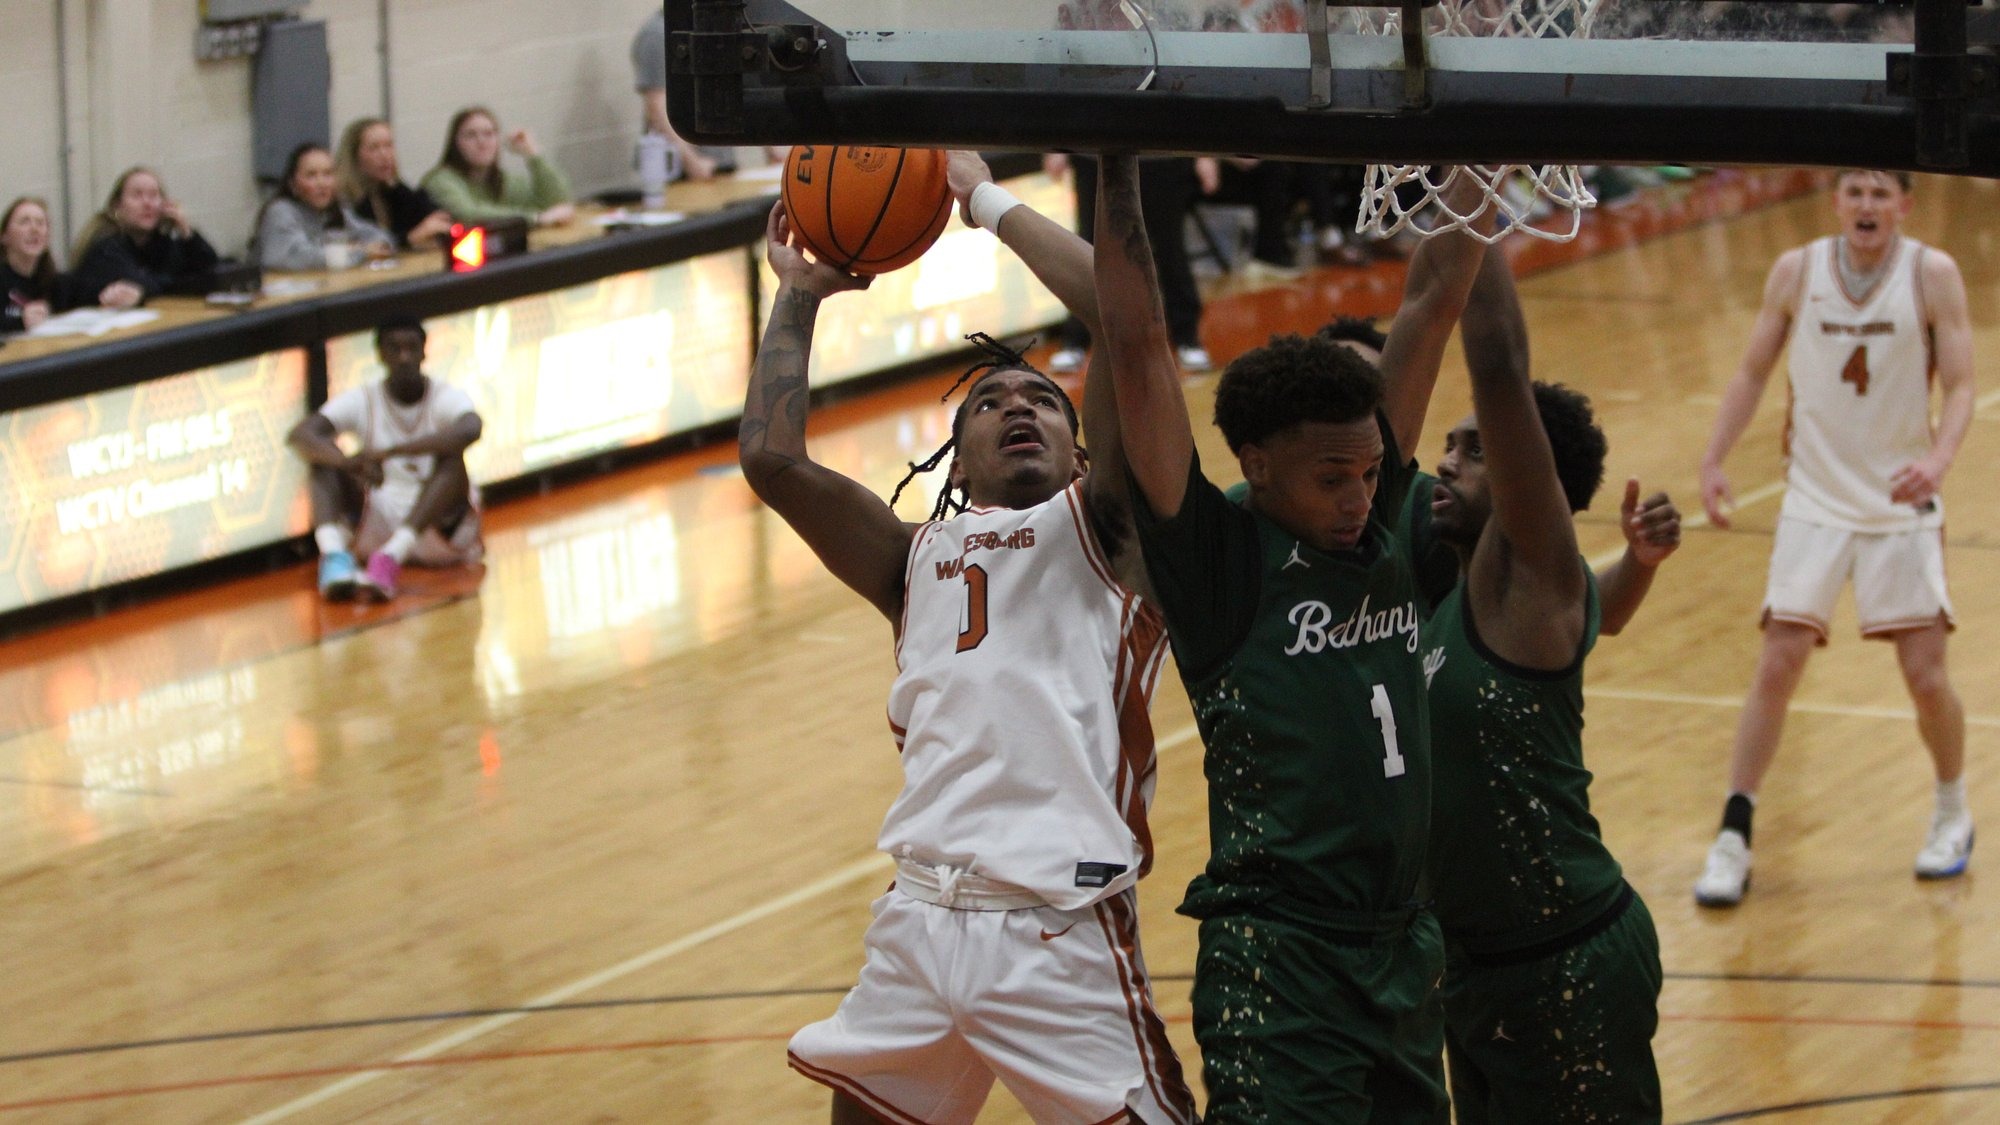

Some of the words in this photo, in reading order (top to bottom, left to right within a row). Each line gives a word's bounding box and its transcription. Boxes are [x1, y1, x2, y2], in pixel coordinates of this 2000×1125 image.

[1841, 344, 1870, 396] 4
[56, 485, 125, 535] WCTV
[219, 457, 248, 495] 14
[1284, 594, 1418, 656] Bethany
[1370, 683, 1406, 779] 1
